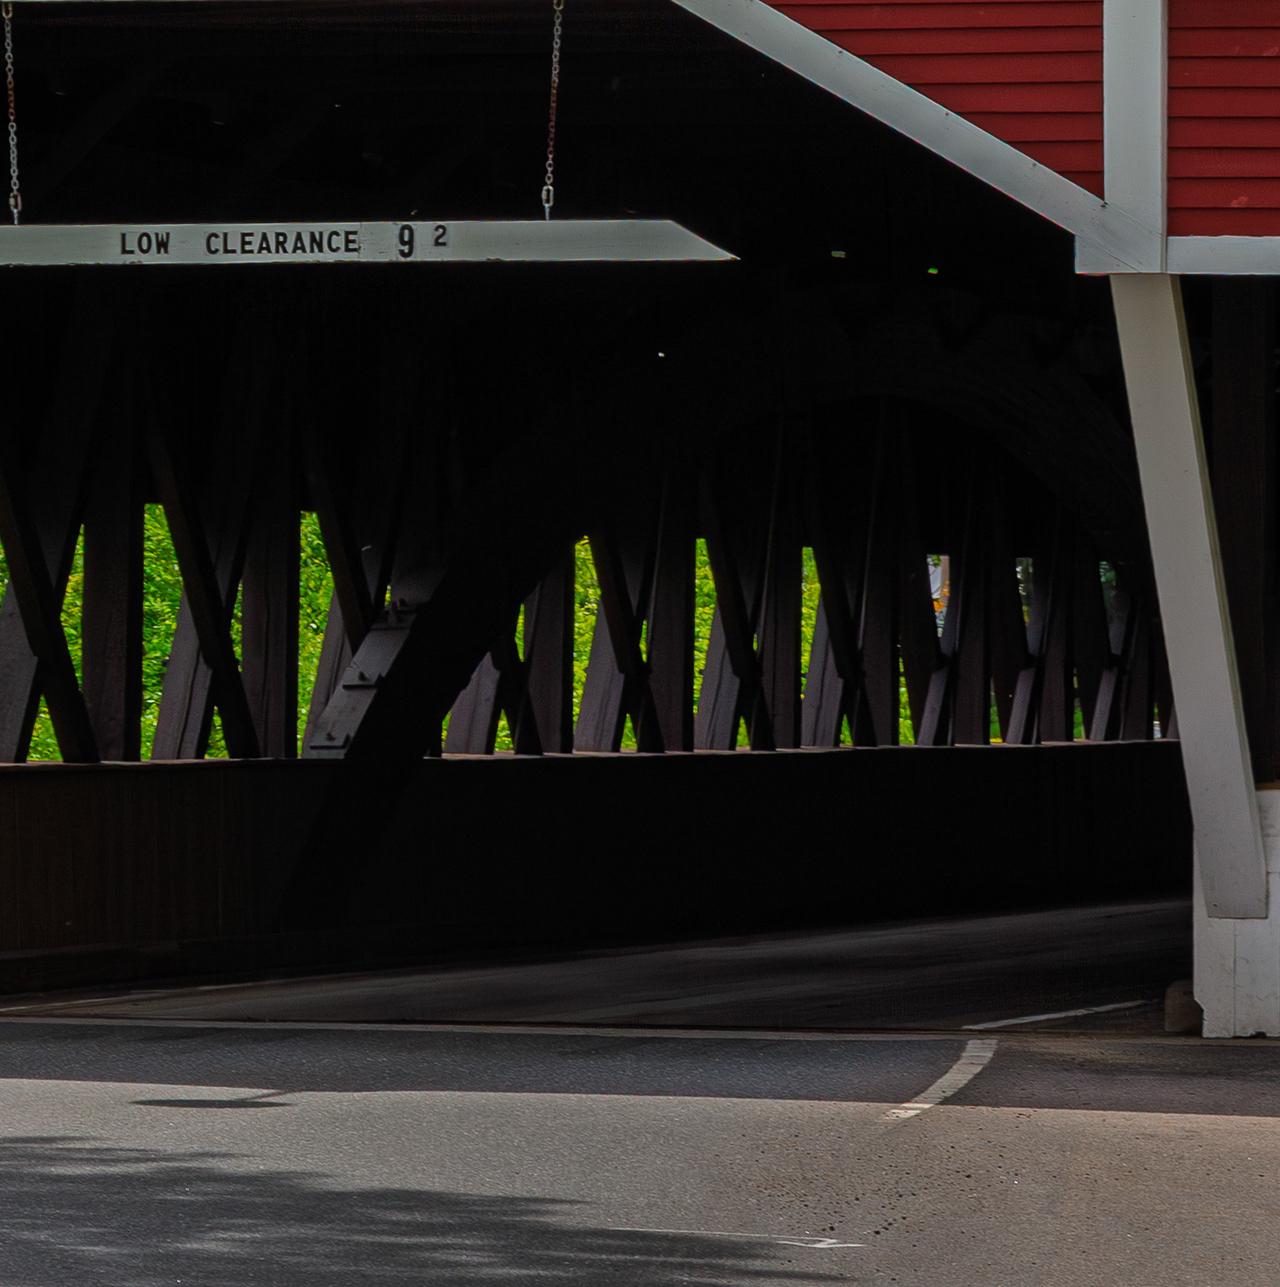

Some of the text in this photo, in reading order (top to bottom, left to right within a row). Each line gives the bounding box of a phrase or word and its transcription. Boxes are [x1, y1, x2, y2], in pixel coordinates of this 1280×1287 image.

[120, 224, 448, 258] LOW CLEARANCE 9 2
